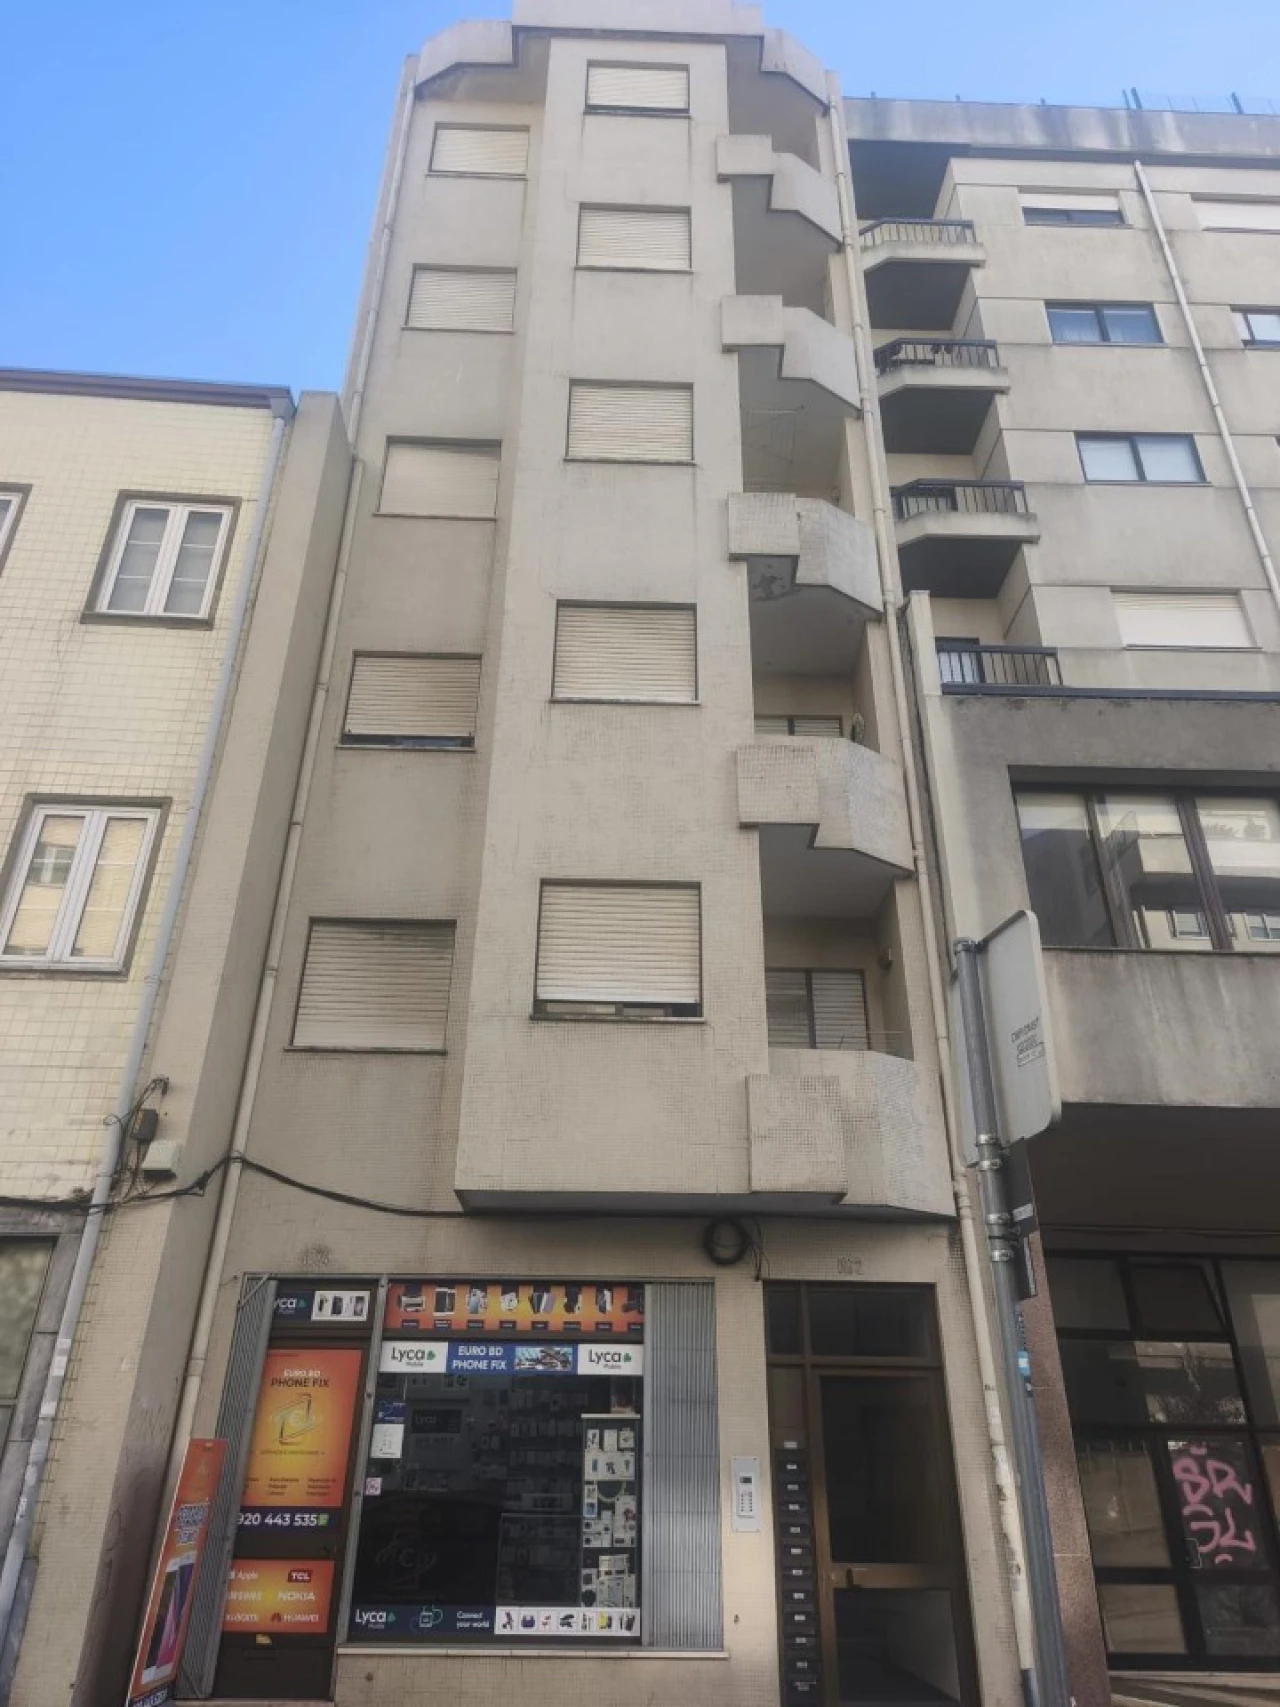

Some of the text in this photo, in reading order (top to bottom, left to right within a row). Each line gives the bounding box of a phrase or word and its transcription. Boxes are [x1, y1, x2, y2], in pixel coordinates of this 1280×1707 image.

[391, 1347, 426, 1362] Lyca
[458, 1346, 503, 1356] EURO BD
[588, 1349, 622, 1364] Lyca
[452, 1360, 507, 1370] PHONE FIX
[270, 1378, 330, 1388] PHONE FIX
[265, 1513, 290, 1526] 443
[294, 1513, 318, 1527] 535
[291, 1572, 310, 1580] TCL
[355, 1609, 386, 1624] Lyca
